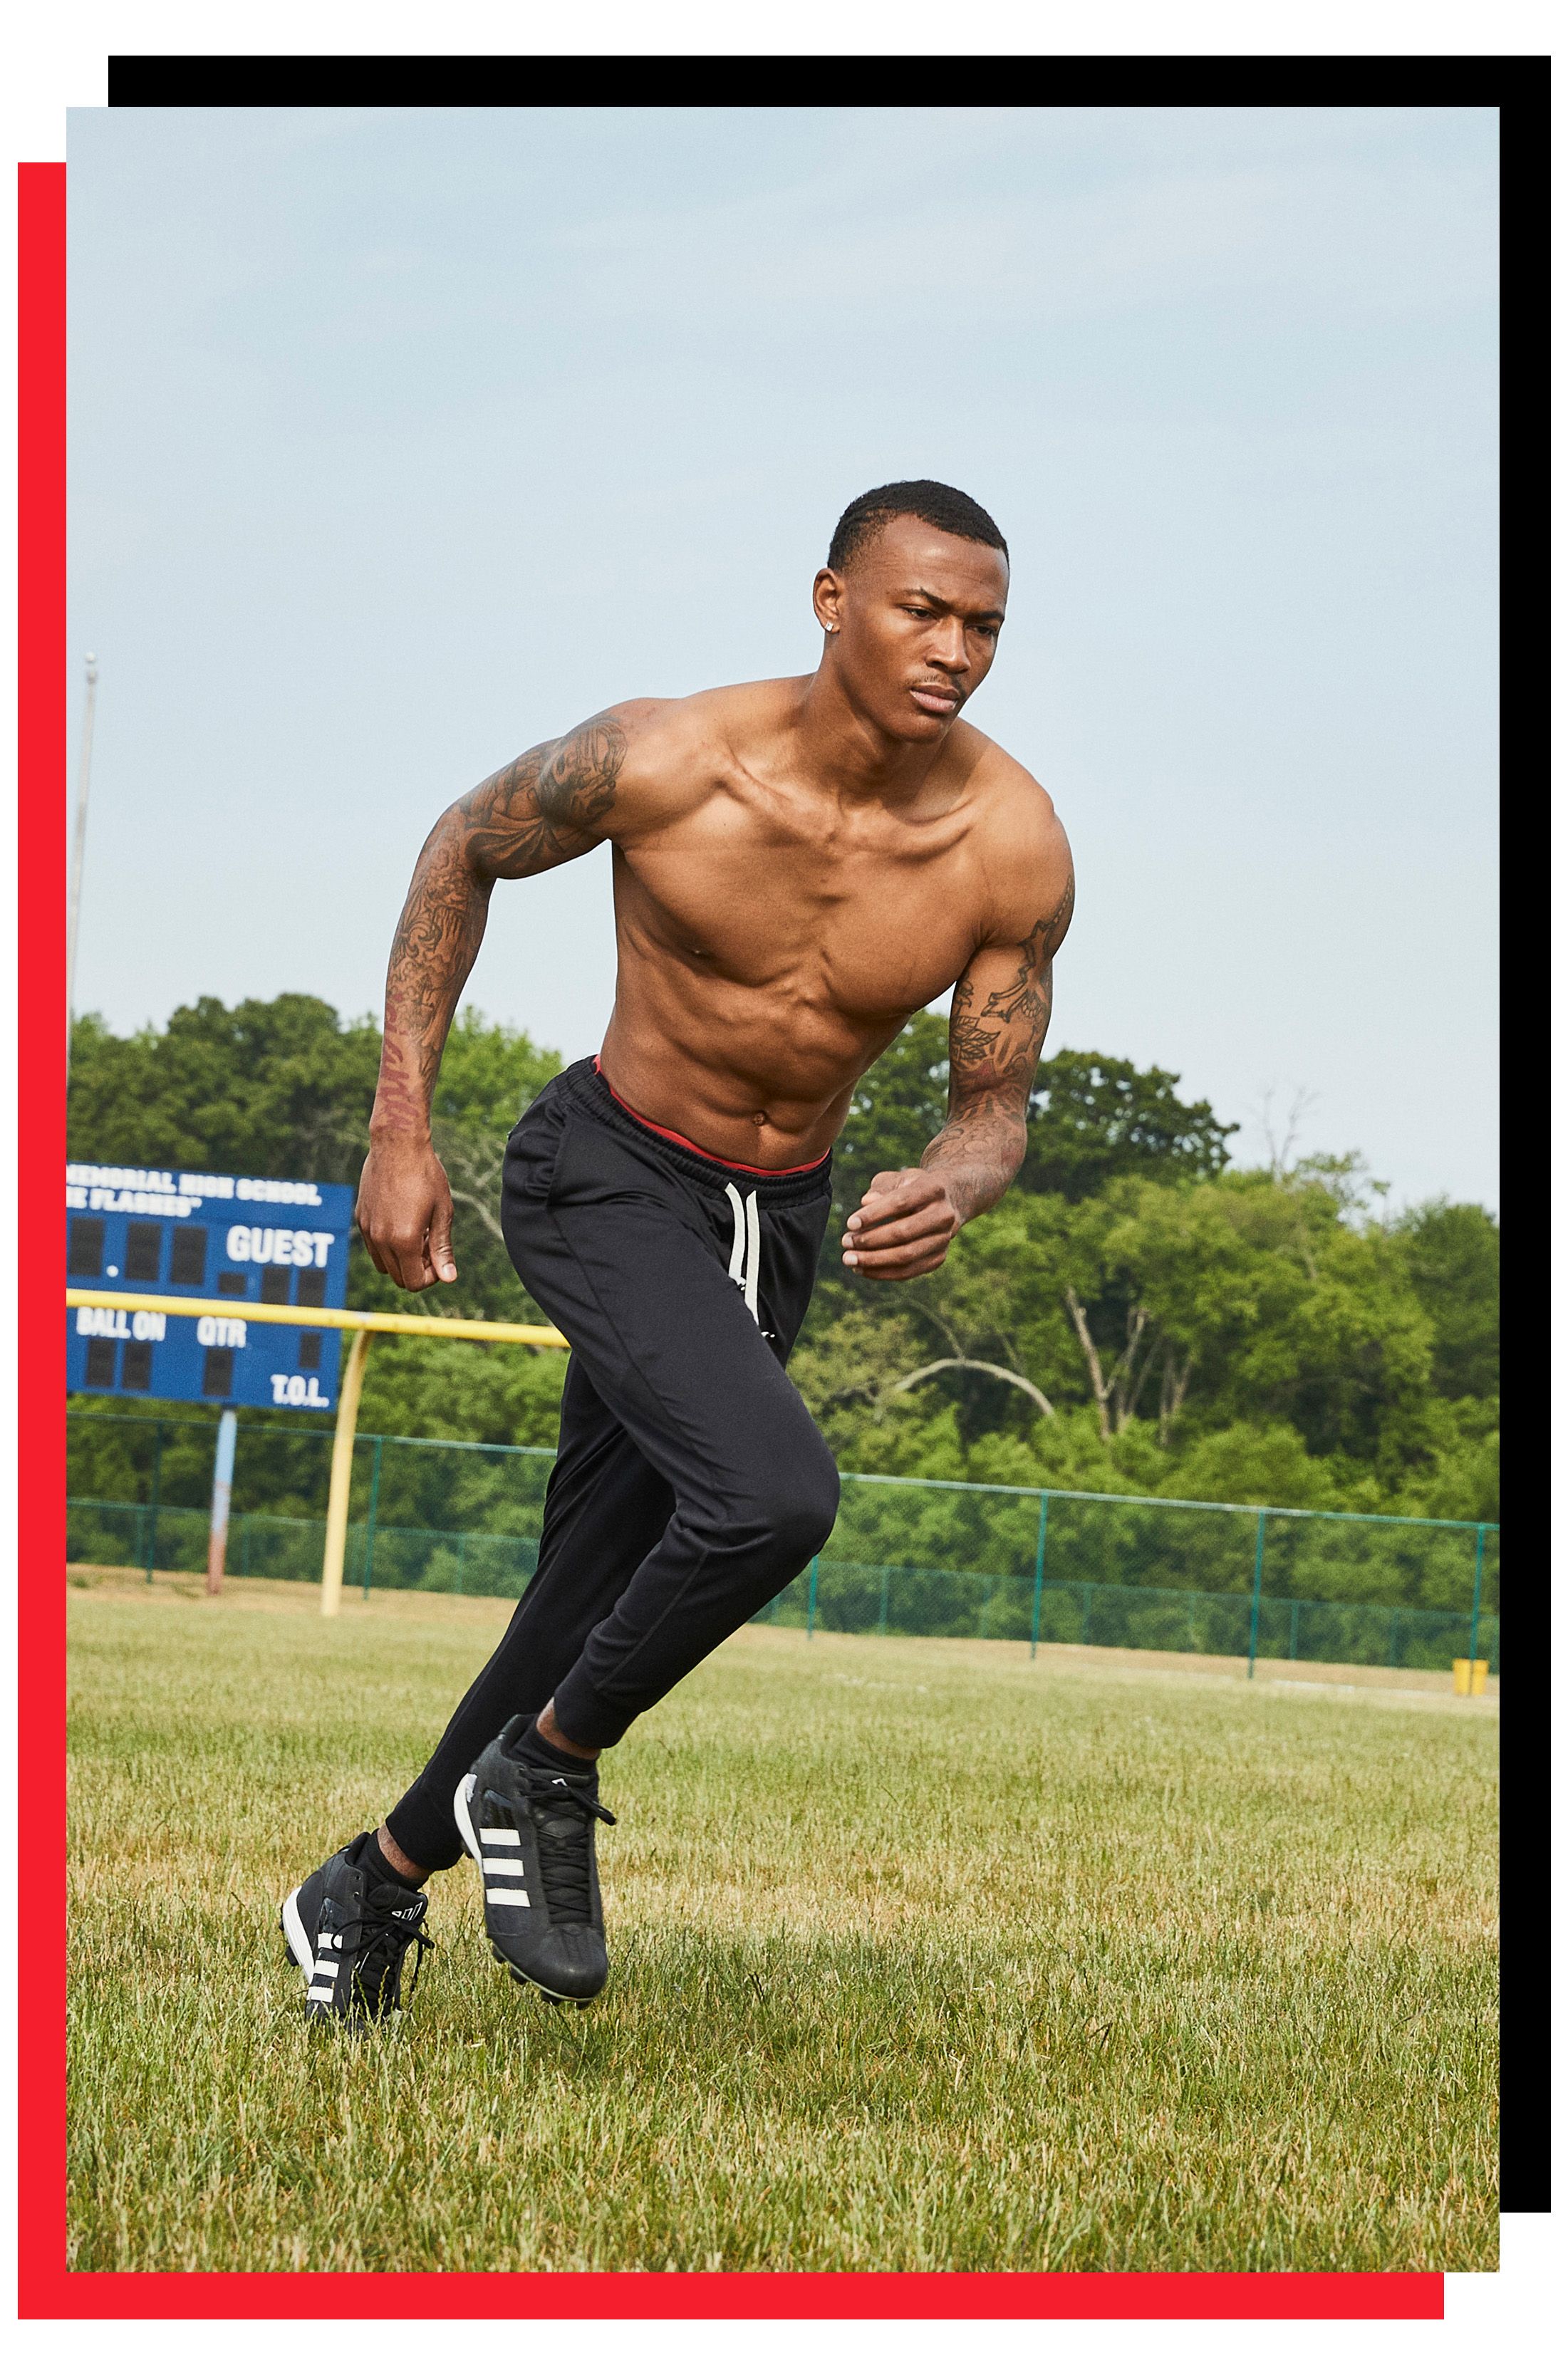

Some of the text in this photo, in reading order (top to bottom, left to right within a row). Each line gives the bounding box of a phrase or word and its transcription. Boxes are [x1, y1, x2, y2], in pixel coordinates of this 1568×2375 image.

[177, 1173, 235, 1199] HIGH
[235, 1178, 323, 1206] SCHOOL
[227, 1225, 335, 1268] GUEST
[76, 1306, 167, 1341] BALL ON
[197, 1316, 247, 1348] QTR
